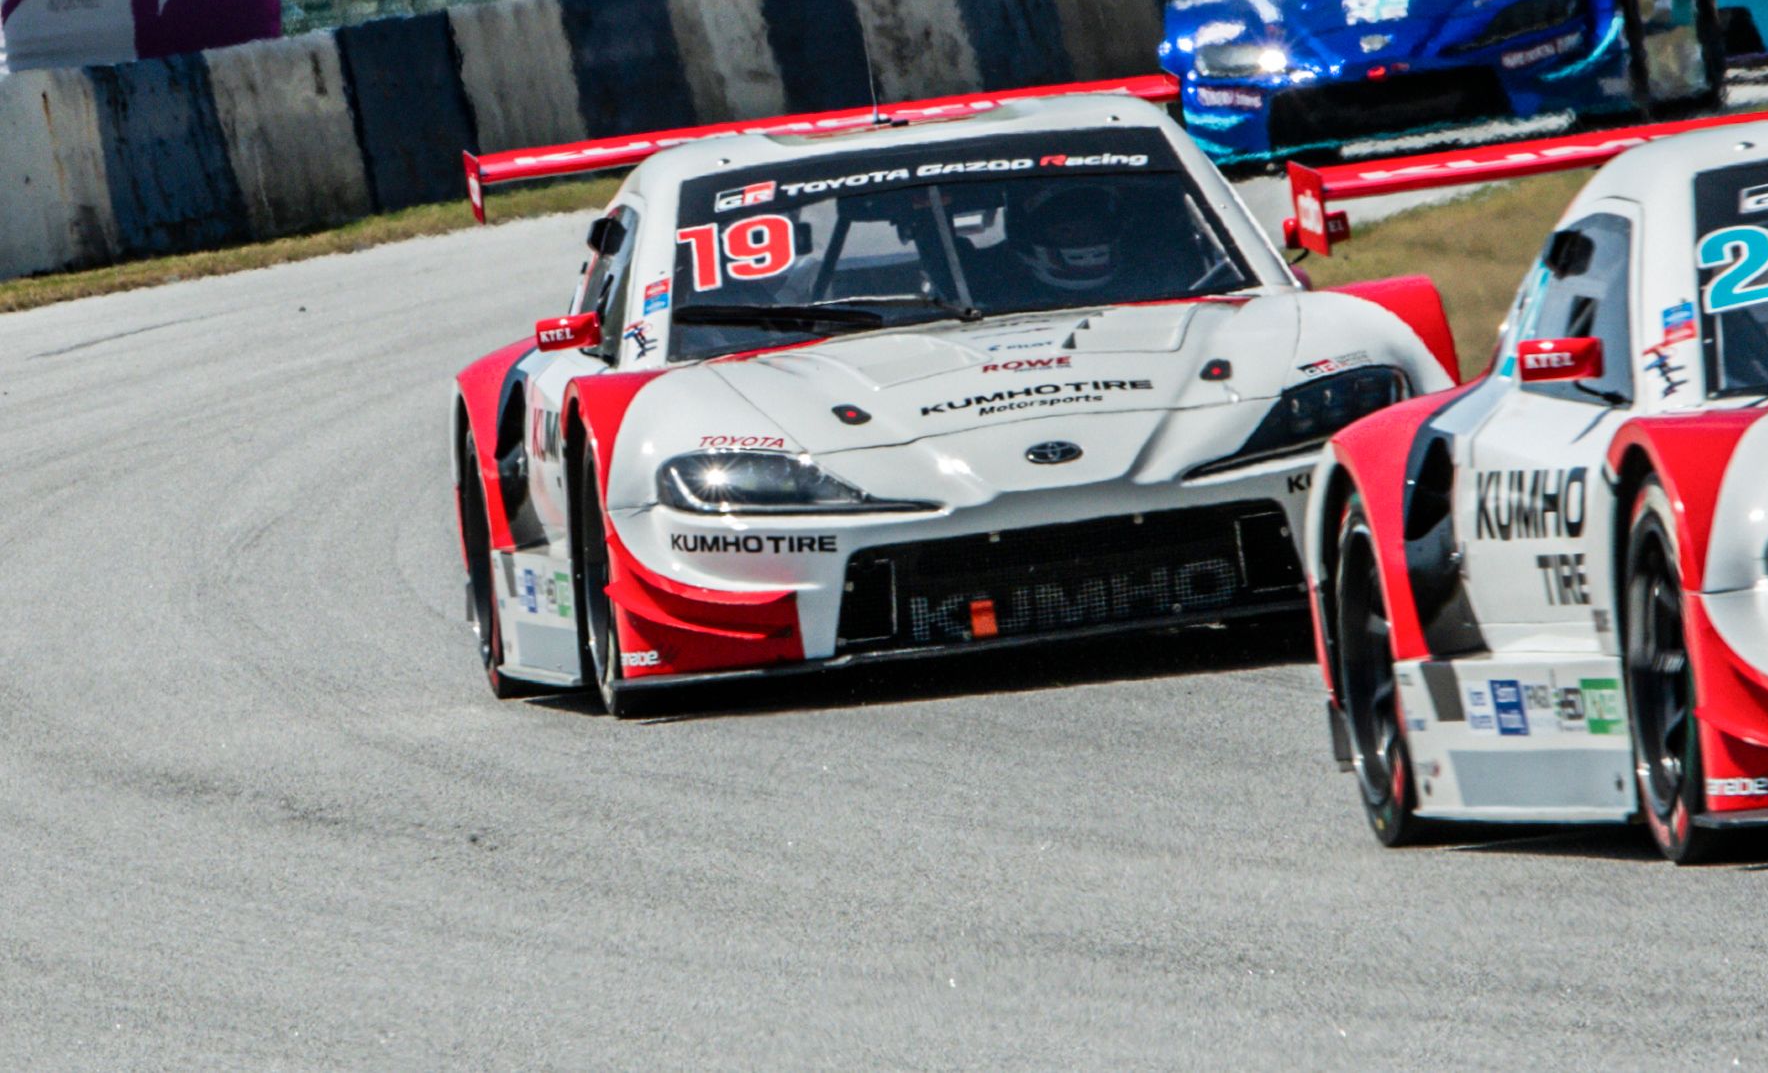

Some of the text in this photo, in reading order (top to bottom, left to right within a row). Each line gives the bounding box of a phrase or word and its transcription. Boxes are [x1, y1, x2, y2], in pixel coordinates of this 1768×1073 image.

[716, 153, 1149, 213] GR TOYOTA GAZOO Racing
[677, 214, 796, 293] 19
[982, 355, 1072, 373] ROWE
[979, 393, 1104, 417] Motorsports
[699, 436, 785, 448] TOYOTA
[1475, 466, 1590, 540] KUMHO
[1536, 552, 1592, 606] TIRE
